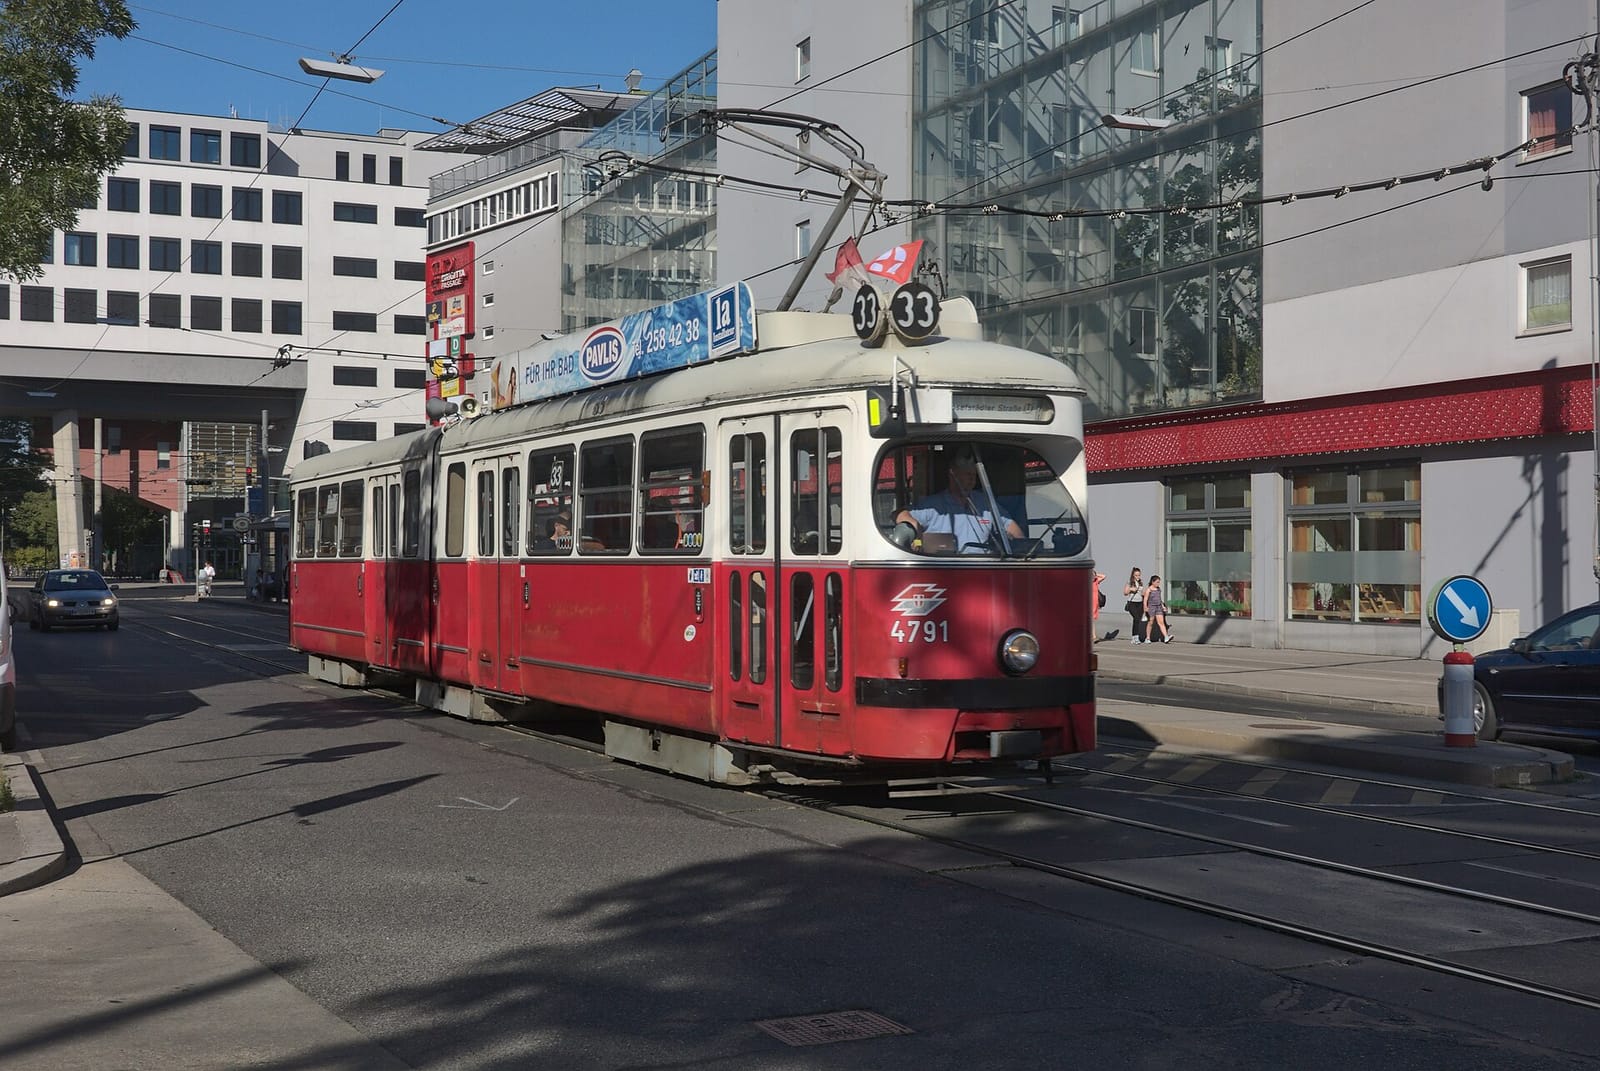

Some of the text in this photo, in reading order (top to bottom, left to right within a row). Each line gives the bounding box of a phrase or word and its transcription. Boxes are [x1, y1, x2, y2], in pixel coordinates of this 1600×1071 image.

[441, 278, 464, 289] PASSAGE
[715, 297, 731, 331] 1a
[856, 292, 877, 331] 33
[897, 290, 934, 328] 33
[646, 327, 666, 354] 258
[668, 322, 683, 347] 42
[685, 317, 700, 343] 38
[585, 338, 619, 369] PAVLIS
[525, 354, 574, 385] FÜR IHR BAD
[550, 465, 562, 487] 33
[890, 620, 948, 643] 4791
